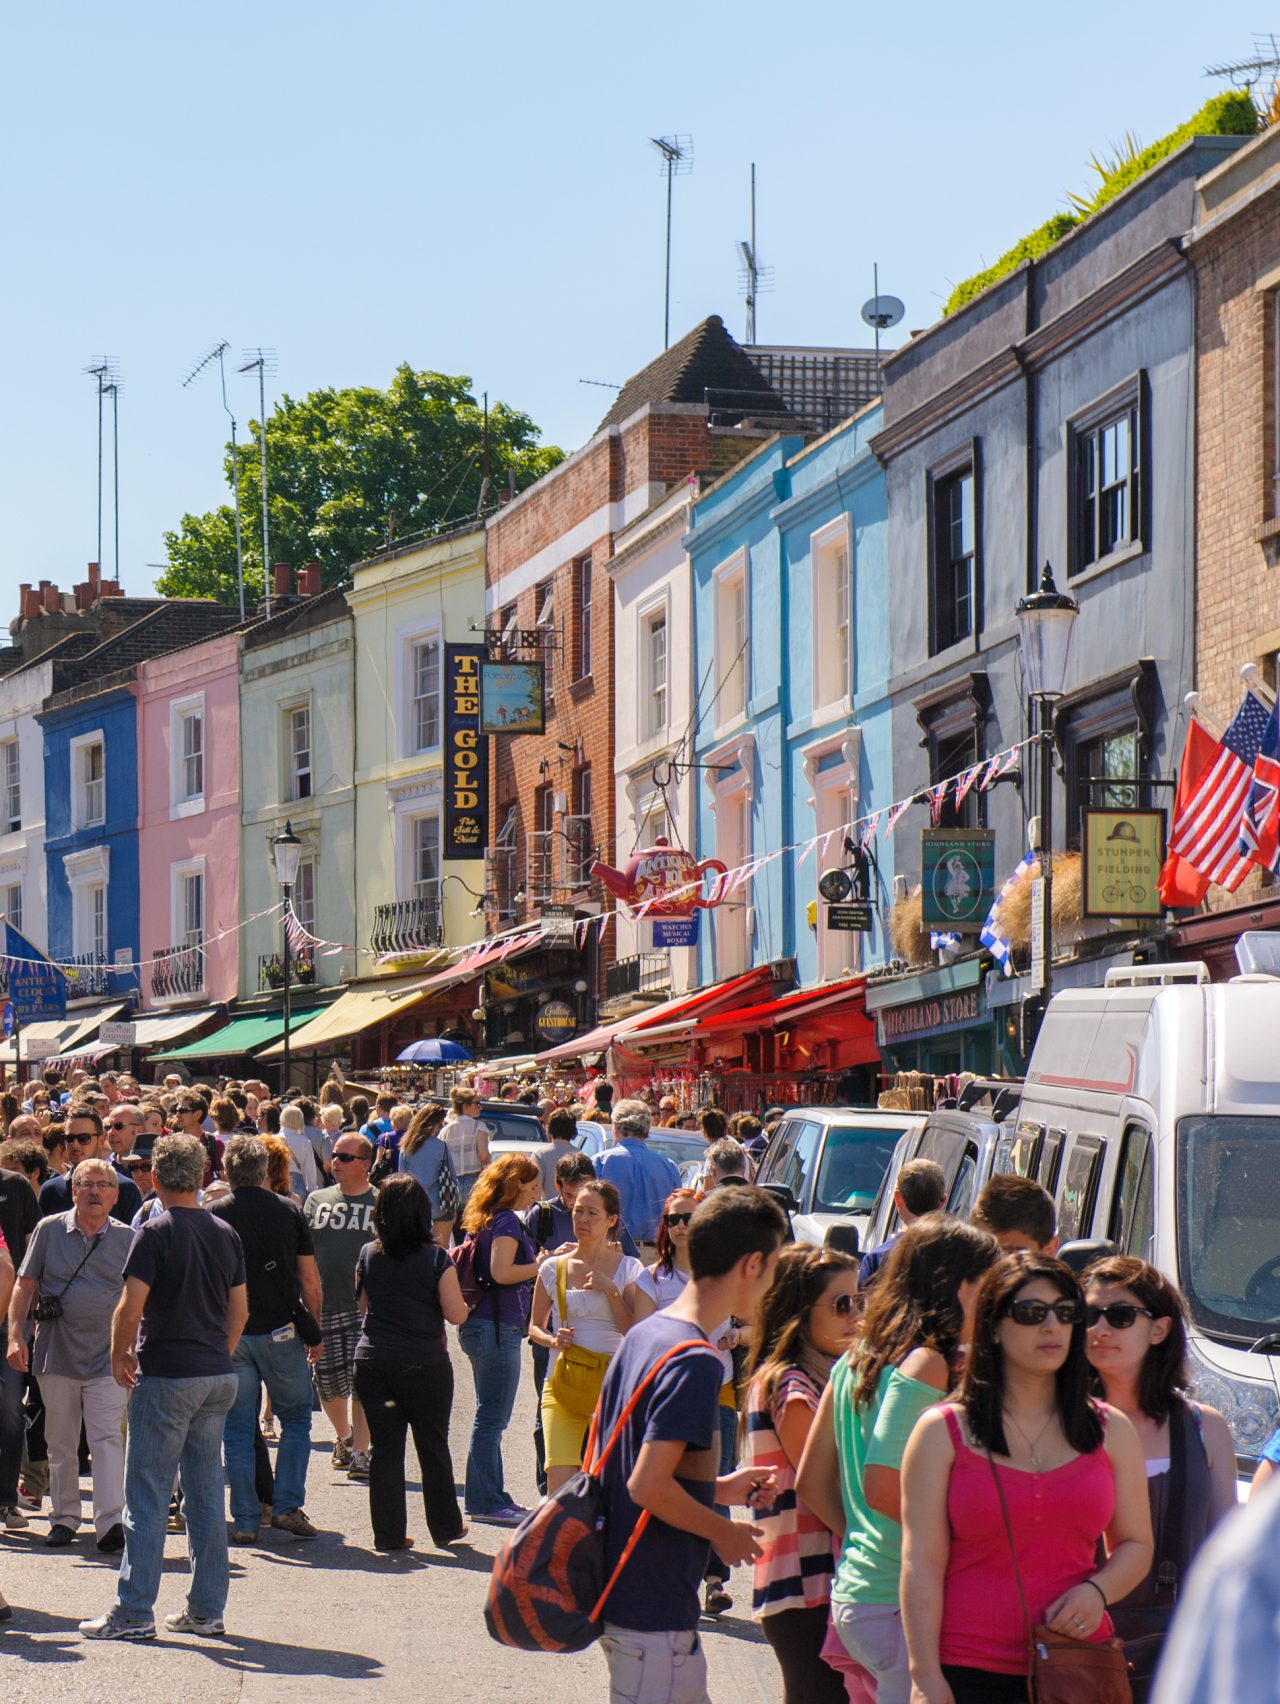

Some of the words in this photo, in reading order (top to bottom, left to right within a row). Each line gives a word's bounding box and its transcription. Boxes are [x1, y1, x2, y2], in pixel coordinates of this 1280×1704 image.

[453, 655, 480, 715] THE
[453, 729, 479, 809] GOLD
[1097, 847, 1151, 857] STUMPER
[1097, 864, 1151, 875] FIELDING
[887, 1002, 941, 1036] HIGHLAND
[942, 993, 978, 1024] STORE
